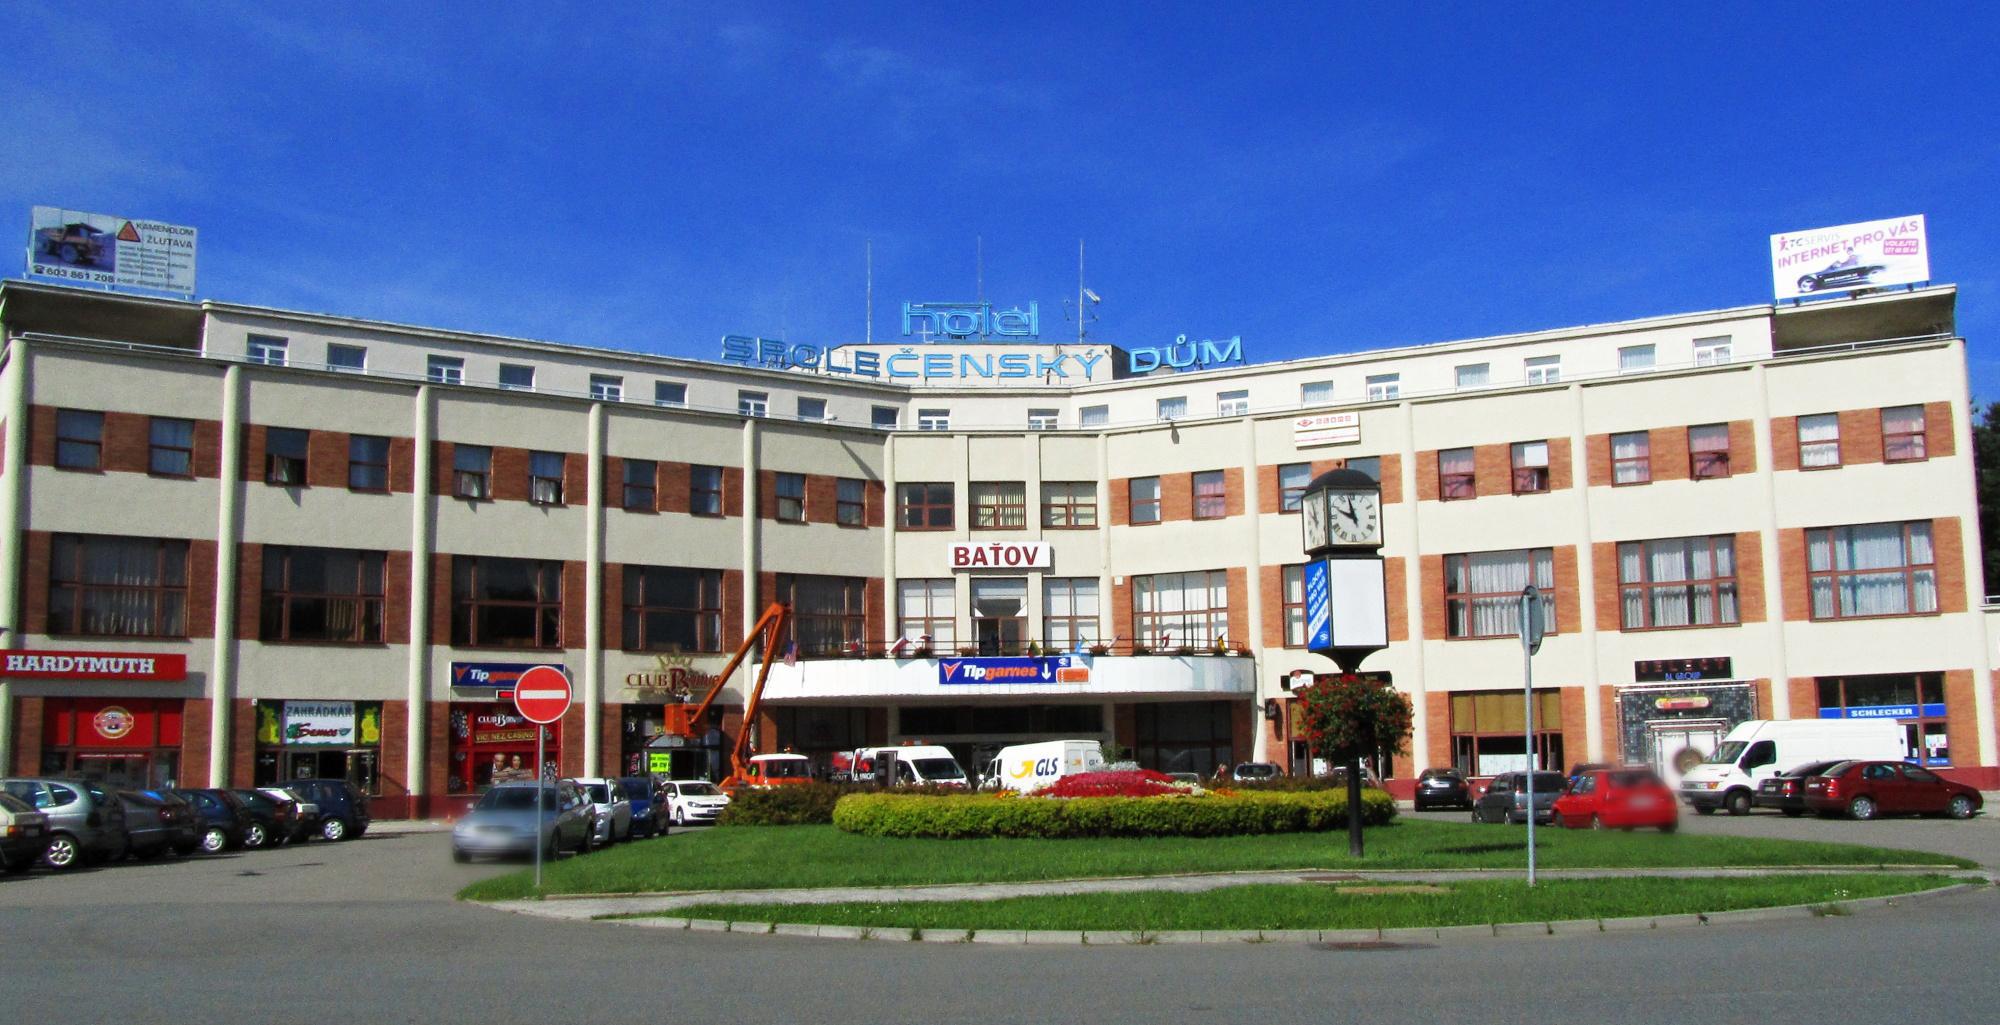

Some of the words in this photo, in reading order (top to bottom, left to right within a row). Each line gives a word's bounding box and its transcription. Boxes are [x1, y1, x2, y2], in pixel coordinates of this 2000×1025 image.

[1778, 240, 1848, 269] INTERNET
[1853, 230, 1884, 248] PRO
[1888, 220, 1918, 237] VÁS
[903, 300, 1039, 336] hotel
[1129, 334, 1243, 373] DŮM
[953, 543, 1039, 566] BAŤOV
[6, 655, 155, 674] HARDTMUTH
[963, 664, 1038, 680] Tipgames
[626, 673, 668, 687] CLUB
[1850, 708, 1913, 717] SCHLECKER
[1036, 757, 1058, 776] GLS
